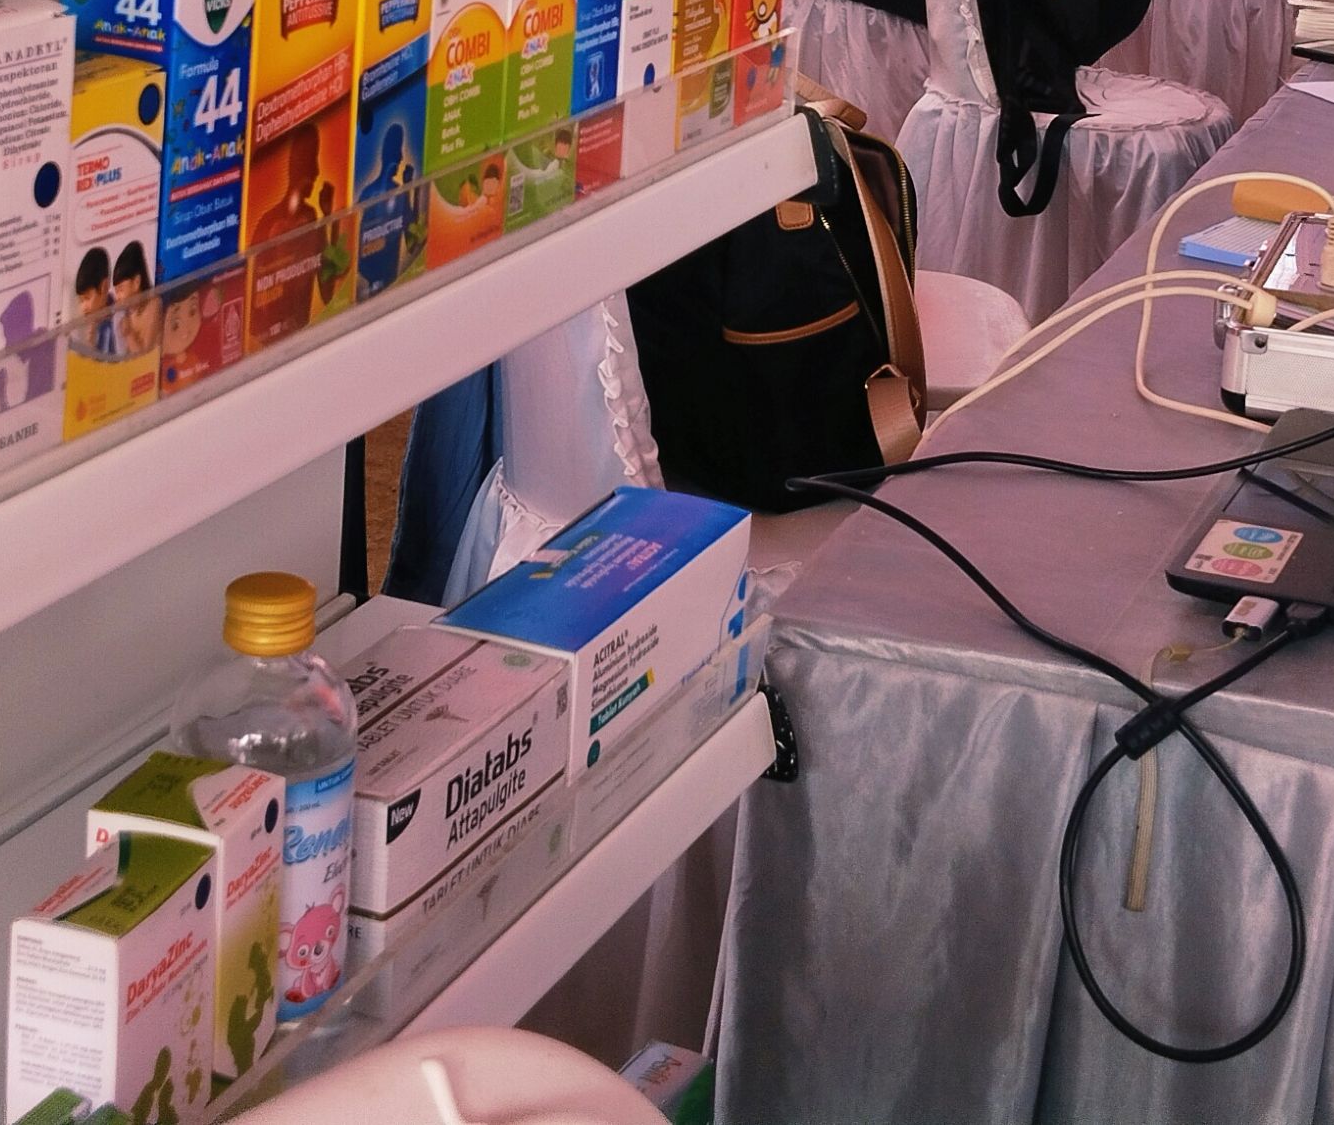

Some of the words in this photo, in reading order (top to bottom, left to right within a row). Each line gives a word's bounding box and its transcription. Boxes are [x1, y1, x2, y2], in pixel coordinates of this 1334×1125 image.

[94, 18, 166, 42] Anak-Anak
[523, 3, 564, 38] COMBI
[179, 57, 220, 80] Formula
[445, 31, 491, 69] COMBI
[192, 66, 243, 134] 44
[170, 132, 245, 176] Anak-Anak
[593, 636, 625, 669] ACITRAL
[445, 726, 533, 819] Diatabs
[446, 767, 527, 851] Attapulgite
[125, 930, 194, 1007] DaryaZinc
